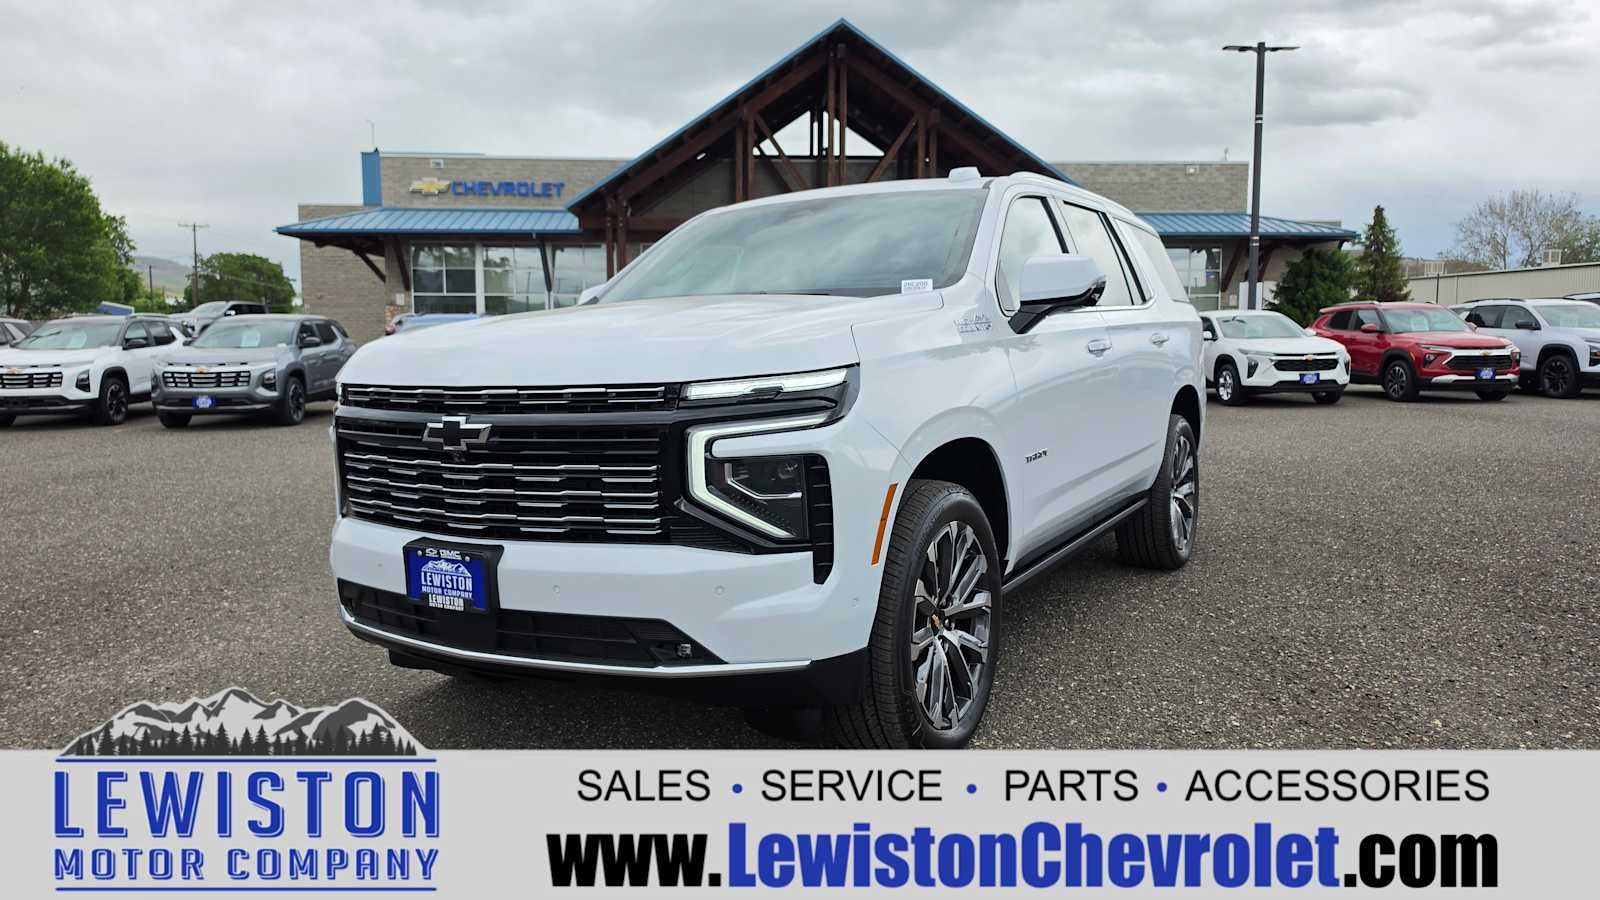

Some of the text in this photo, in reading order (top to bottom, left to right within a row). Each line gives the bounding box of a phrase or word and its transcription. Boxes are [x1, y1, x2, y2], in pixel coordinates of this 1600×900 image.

[451, 181, 565, 197] CHEVROLET
[440, 549, 462, 557] GMC
[421, 571, 472, 591] LEWISTON
[422, 585, 473, 599] MOTOR COMPANY
[428, 594, 464, 607] LEWISTON
